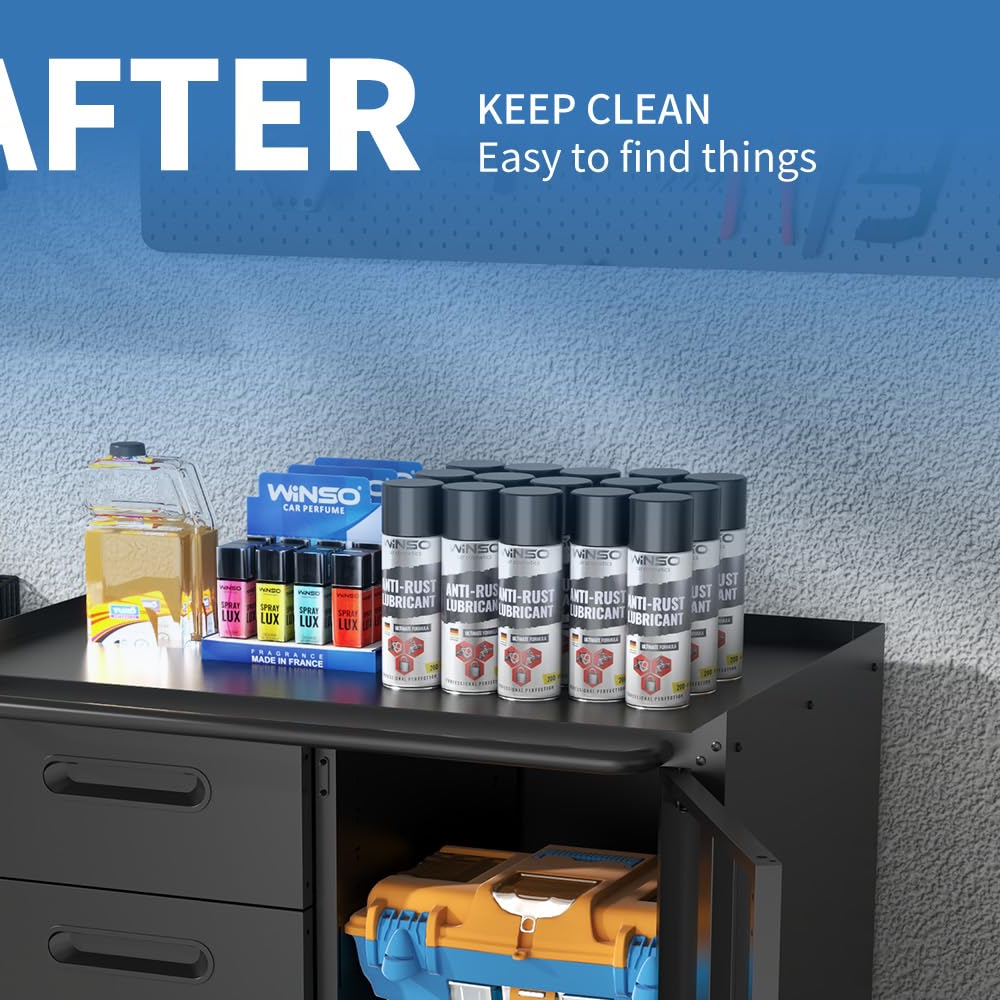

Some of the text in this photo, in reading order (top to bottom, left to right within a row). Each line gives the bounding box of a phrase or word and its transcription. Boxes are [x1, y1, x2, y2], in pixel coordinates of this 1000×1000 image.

[283, 503, 345, 515] CAR PERFUME
[446, 583, 498, 598] ANTI-RUS
[221, 601, 240, 609] SPRAY
[382, 593, 436, 609] LUBRICANT
[446, 598, 498, 613] LUBRICAN
[260, 603, 280, 612] SPRAY
[299, 607, 319, 615] SPRAY
[338, 609, 358, 617] SPRAY
[499, 603, 554, 619] LUBRICANT
[570, 604, 625, 620] LUBRICANT
[221, 610, 240, 622] LUX
[260, 613, 280, 625] LUX
[299, 616, 319, 628] LUX
[627, 610, 683, 627] LUBRICANT
[338, 618, 358, 631] LUX
[251, 649, 323, 660] FRAGRANCE
[252, 655, 323, 668] MADE IN FRANCE
